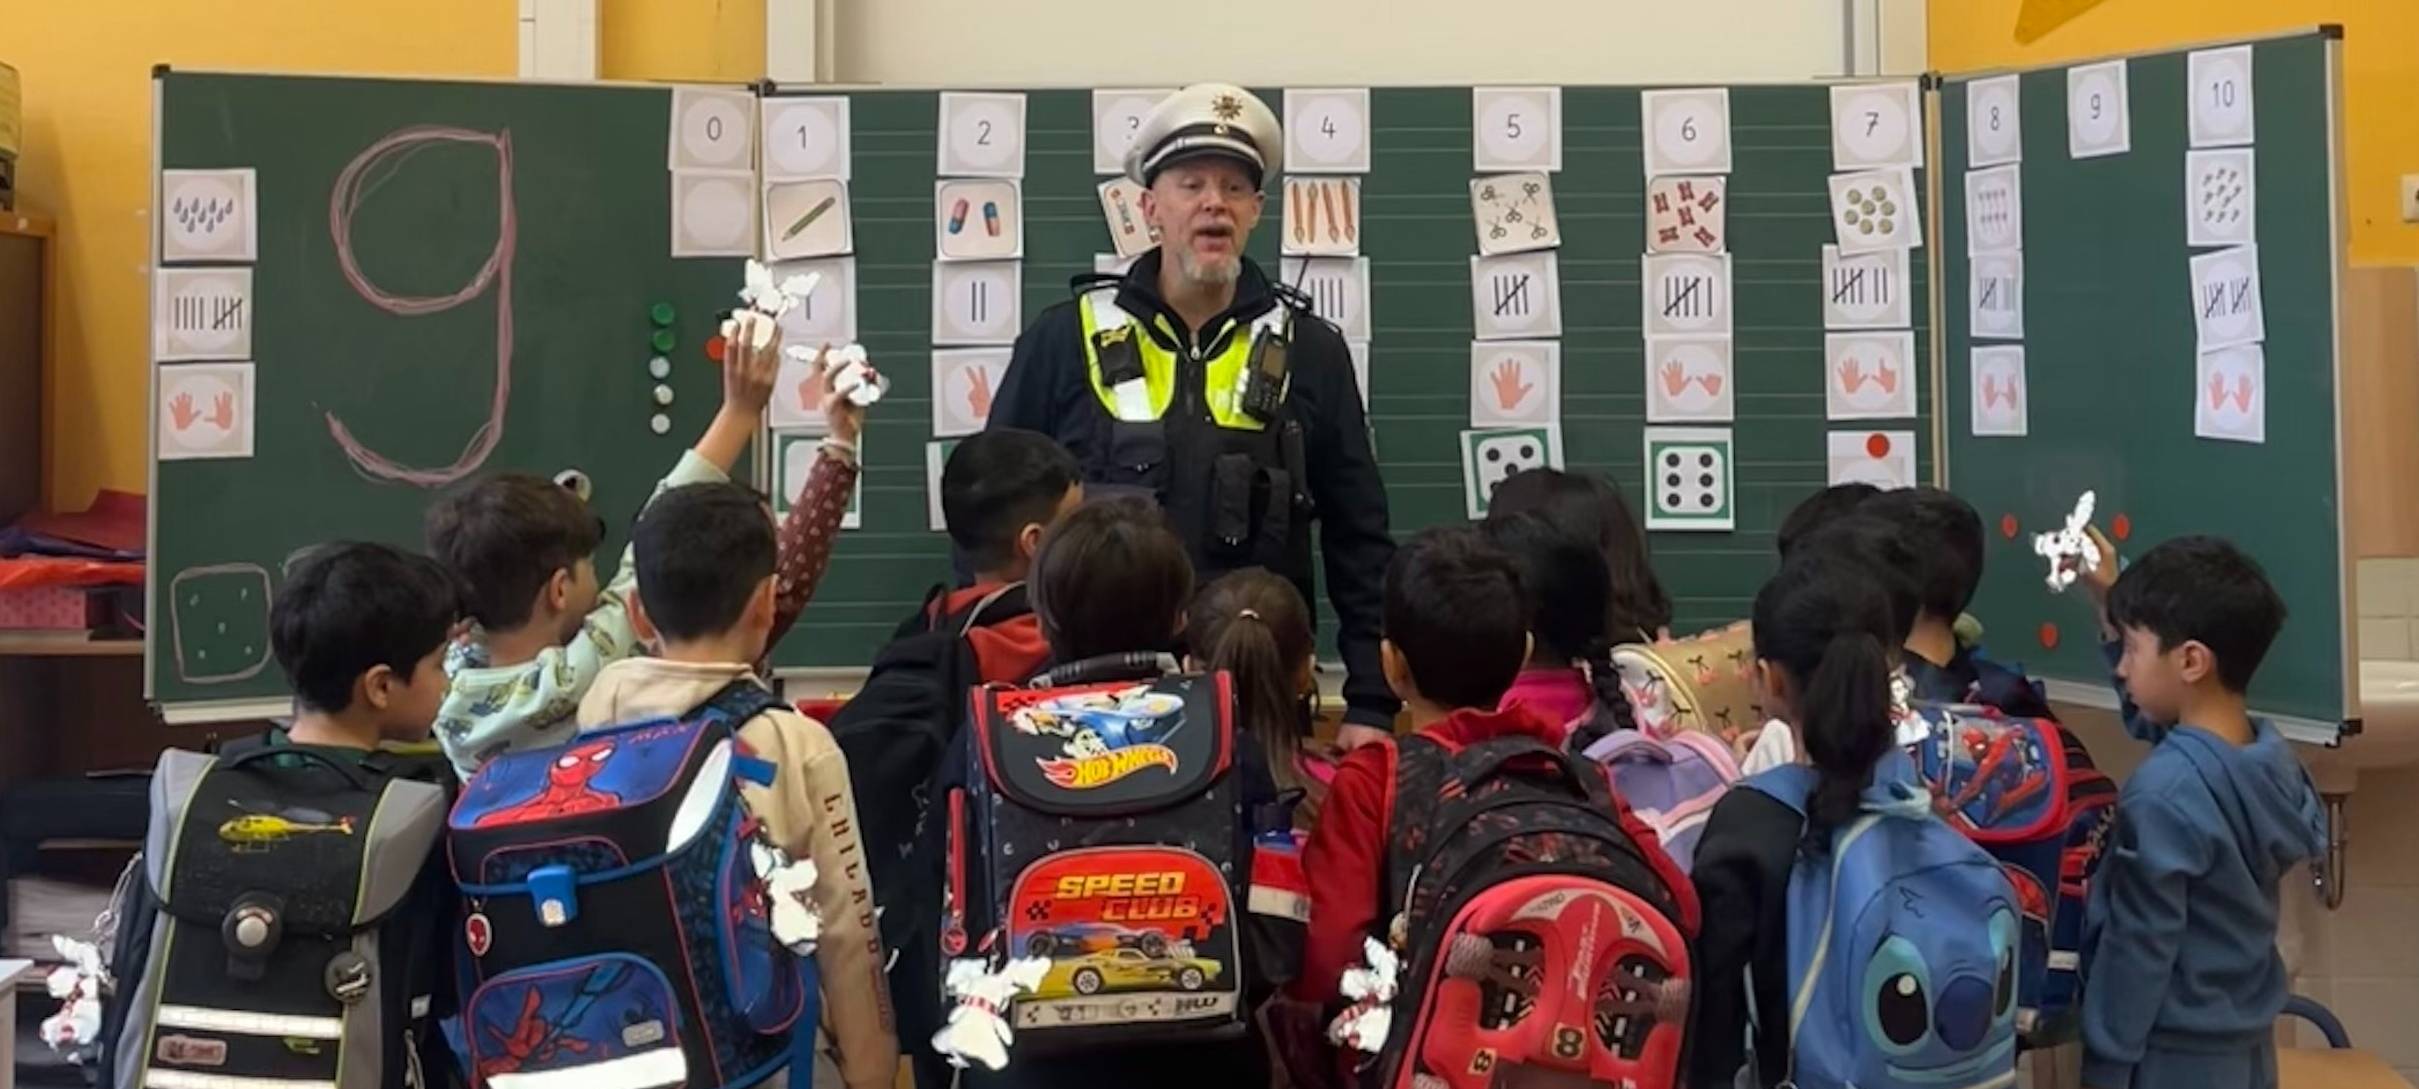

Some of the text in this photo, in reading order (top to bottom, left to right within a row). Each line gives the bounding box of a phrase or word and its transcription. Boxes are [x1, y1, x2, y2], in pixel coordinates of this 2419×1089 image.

[2090, 93, 2101, 120] 9
[2212, 79, 2235, 108] 10
[1320, 116, 1336, 140] 4
[1506, 113, 1521, 139] 5
[1681, 118, 1697, 142] 6
[1865, 111, 1880, 137] 7
[1990, 106, 2000, 131] 8
[796, 124, 807, 150] 1
[976, 120, 991, 145] 2
[1078, 754, 1113, 785] HOT
[1056, 871, 1186, 899] SPEED
[1102, 896, 1200, 921] CLUB
[1556, 1026, 1585, 1058] 8
[1473, 1049, 1493, 1073] 8
